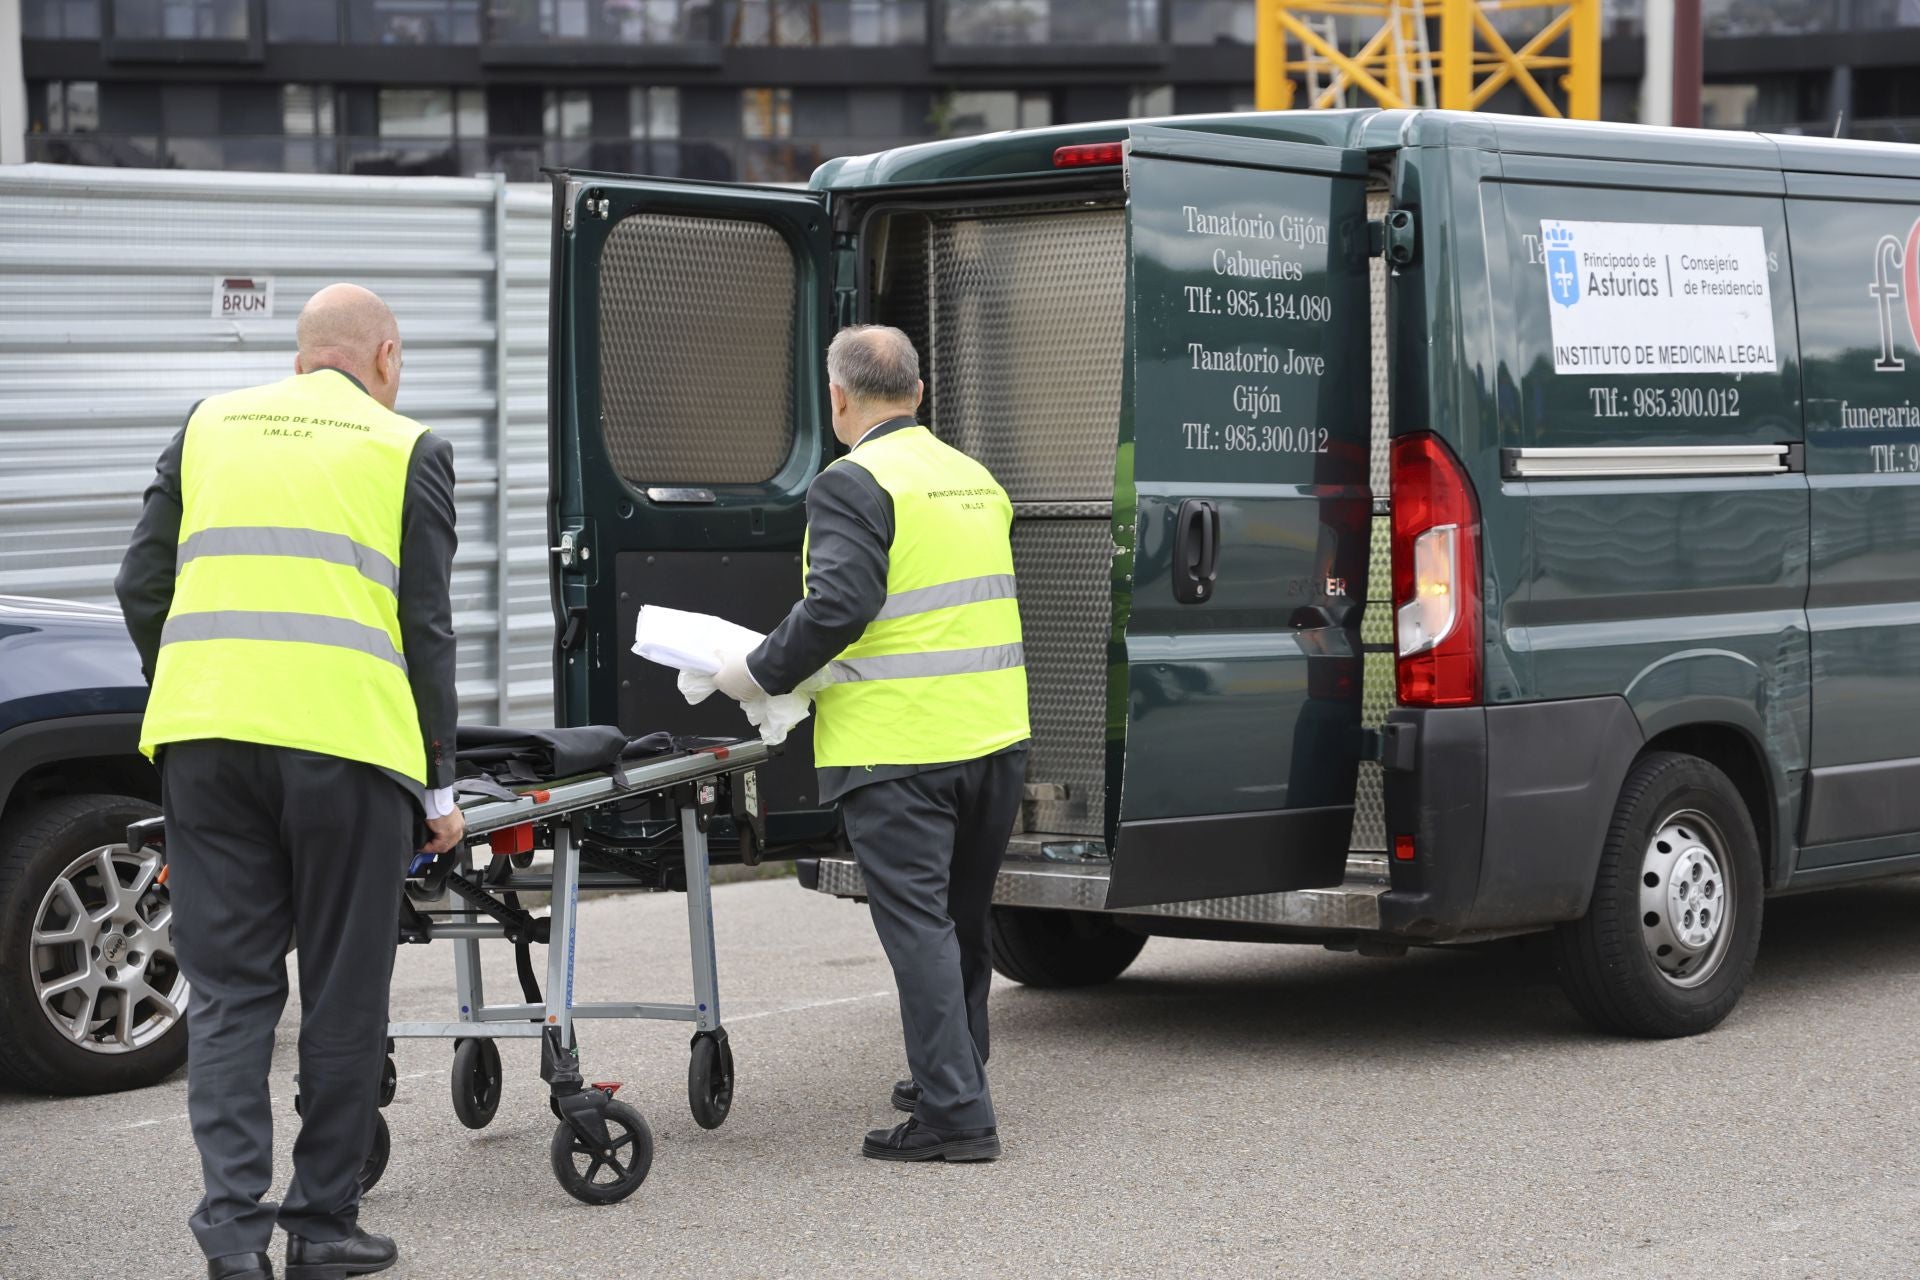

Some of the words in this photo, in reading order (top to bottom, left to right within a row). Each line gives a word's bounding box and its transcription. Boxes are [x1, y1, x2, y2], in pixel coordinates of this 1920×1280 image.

[1182, 205, 1275, 240] Tanatorio
[1279, 214, 1328, 250] Gijón
[1212, 248, 1303, 281] Cabueñes
[1583, 253, 1640, 270] Principado
[1642, 254, 1656, 269] de
[1681, 253, 1739, 274] Consejería
[1588, 271, 1659, 297] Asturias
[1684, 280, 1698, 296] de
[1701, 279, 1763, 297] Presidencia
[223, 295, 266, 311] BRUN
[1184, 286, 1222, 315] Tlf.:
[1226, 289, 1332, 322] 985.134.080
[1188, 343, 1279, 374] Tanatorio
[1283, 348, 1325, 376] Jove
[1556, 345, 1631, 366] INSTITUTO
[1636, 345, 1654, 365] DE
[1659, 345, 1727, 364] MEDICINA
[1730, 344, 1774, 364] LEGAL
[1232, 384, 1282, 420] Gijón
[1589, 387, 1629, 417] Tlf.:
[1633, 387, 1740, 417] 985.300.012
[1840, 399, 1920, 429] funeraria
[224, 413, 290, 423] PRINCIPADO
[293, 415, 309, 424] DE
[311, 418, 371, 432] ASTURIAS
[263, 428, 313, 439] I.M.L.C.F.
[1182, 422, 1219, 451] Tlf.:
[1224, 424, 1329, 453] 985.300.012
[1869, 443, 1904, 473] Tlf.:
